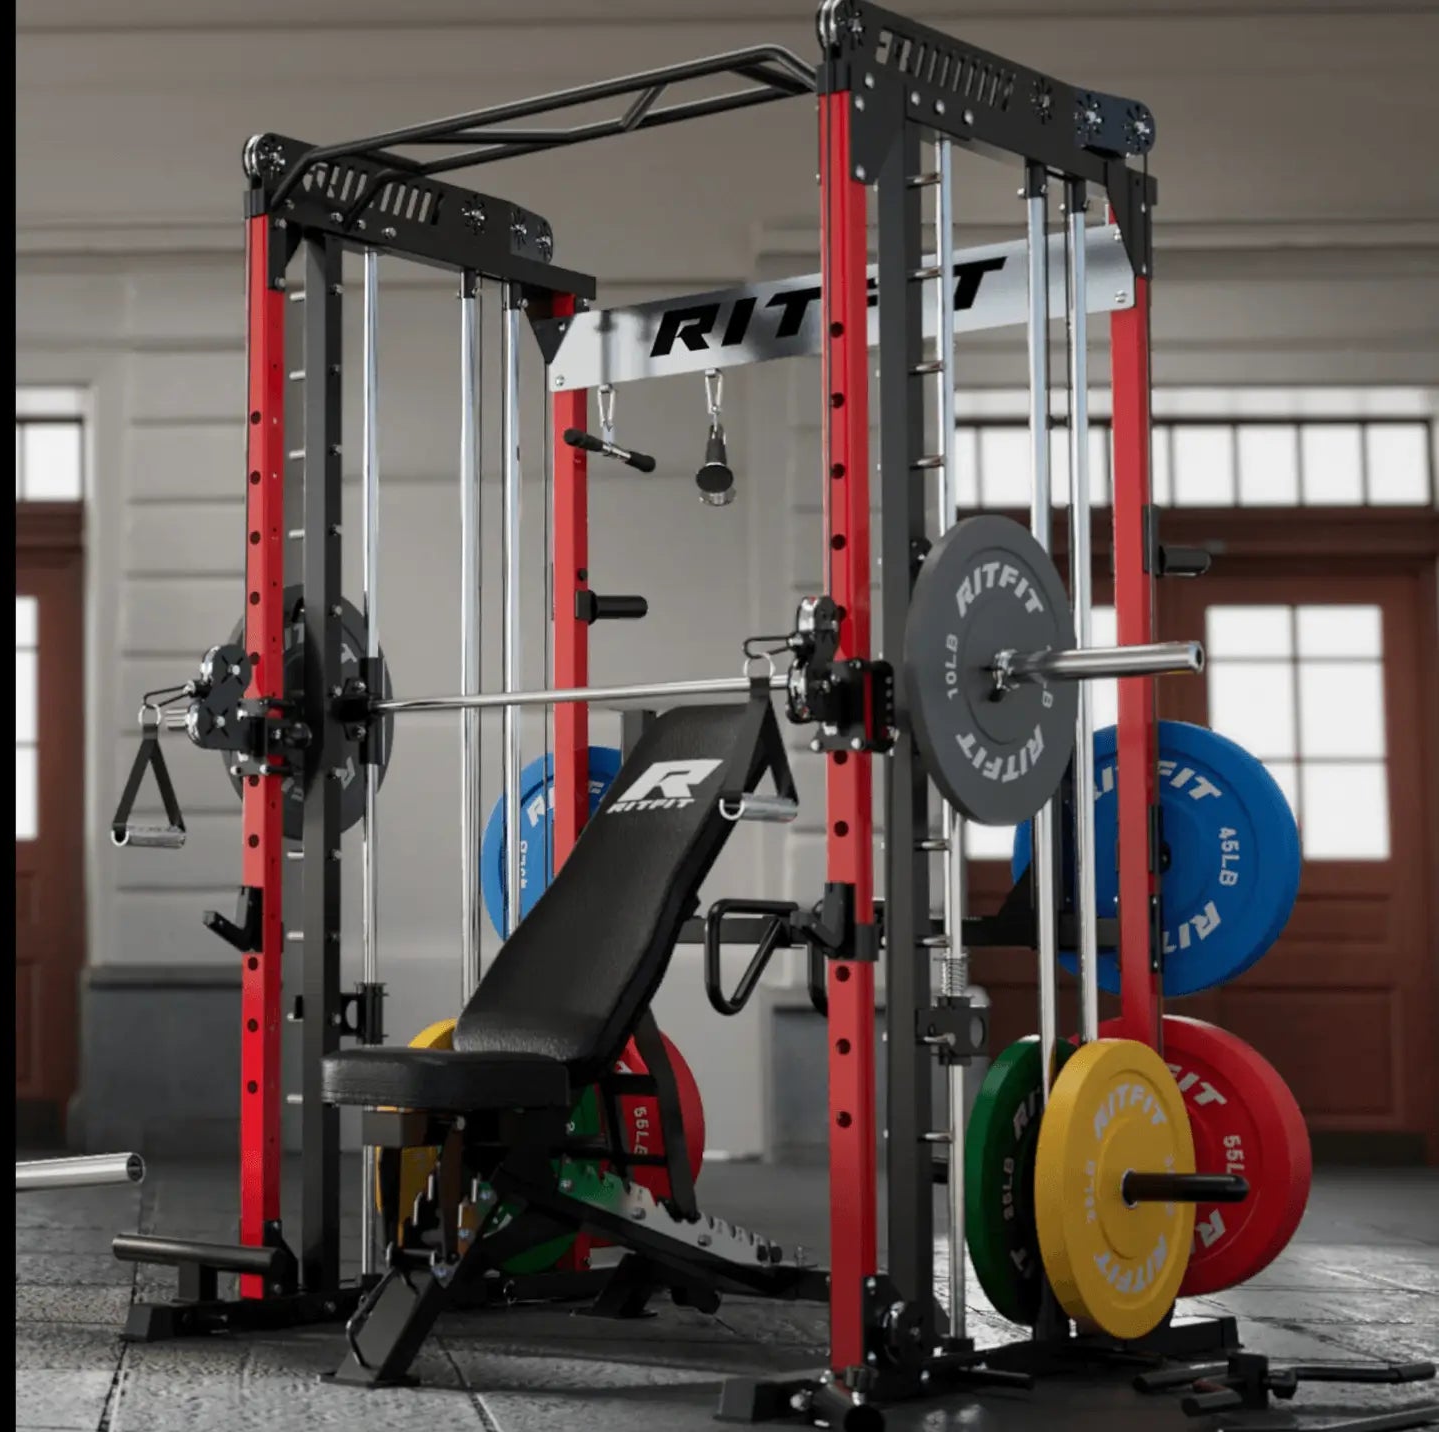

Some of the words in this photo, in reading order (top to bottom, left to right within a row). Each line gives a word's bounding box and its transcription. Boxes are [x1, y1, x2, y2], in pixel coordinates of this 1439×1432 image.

[650, 256, 1007, 358] RITT
[956, 562, 1044, 618] RITFIT
[945, 634, 958, 699] 10LB
[955, 723, 1044, 783] RITFIT
[606, 798, 695, 814] RITFIT
[1217, 827, 1240, 886] 45LB
[1093, 1082, 1167, 1140] RITFIT
[1223, 1135, 1245, 1175] 55L
[1094, 1233, 1167, 1294] RITFIT
